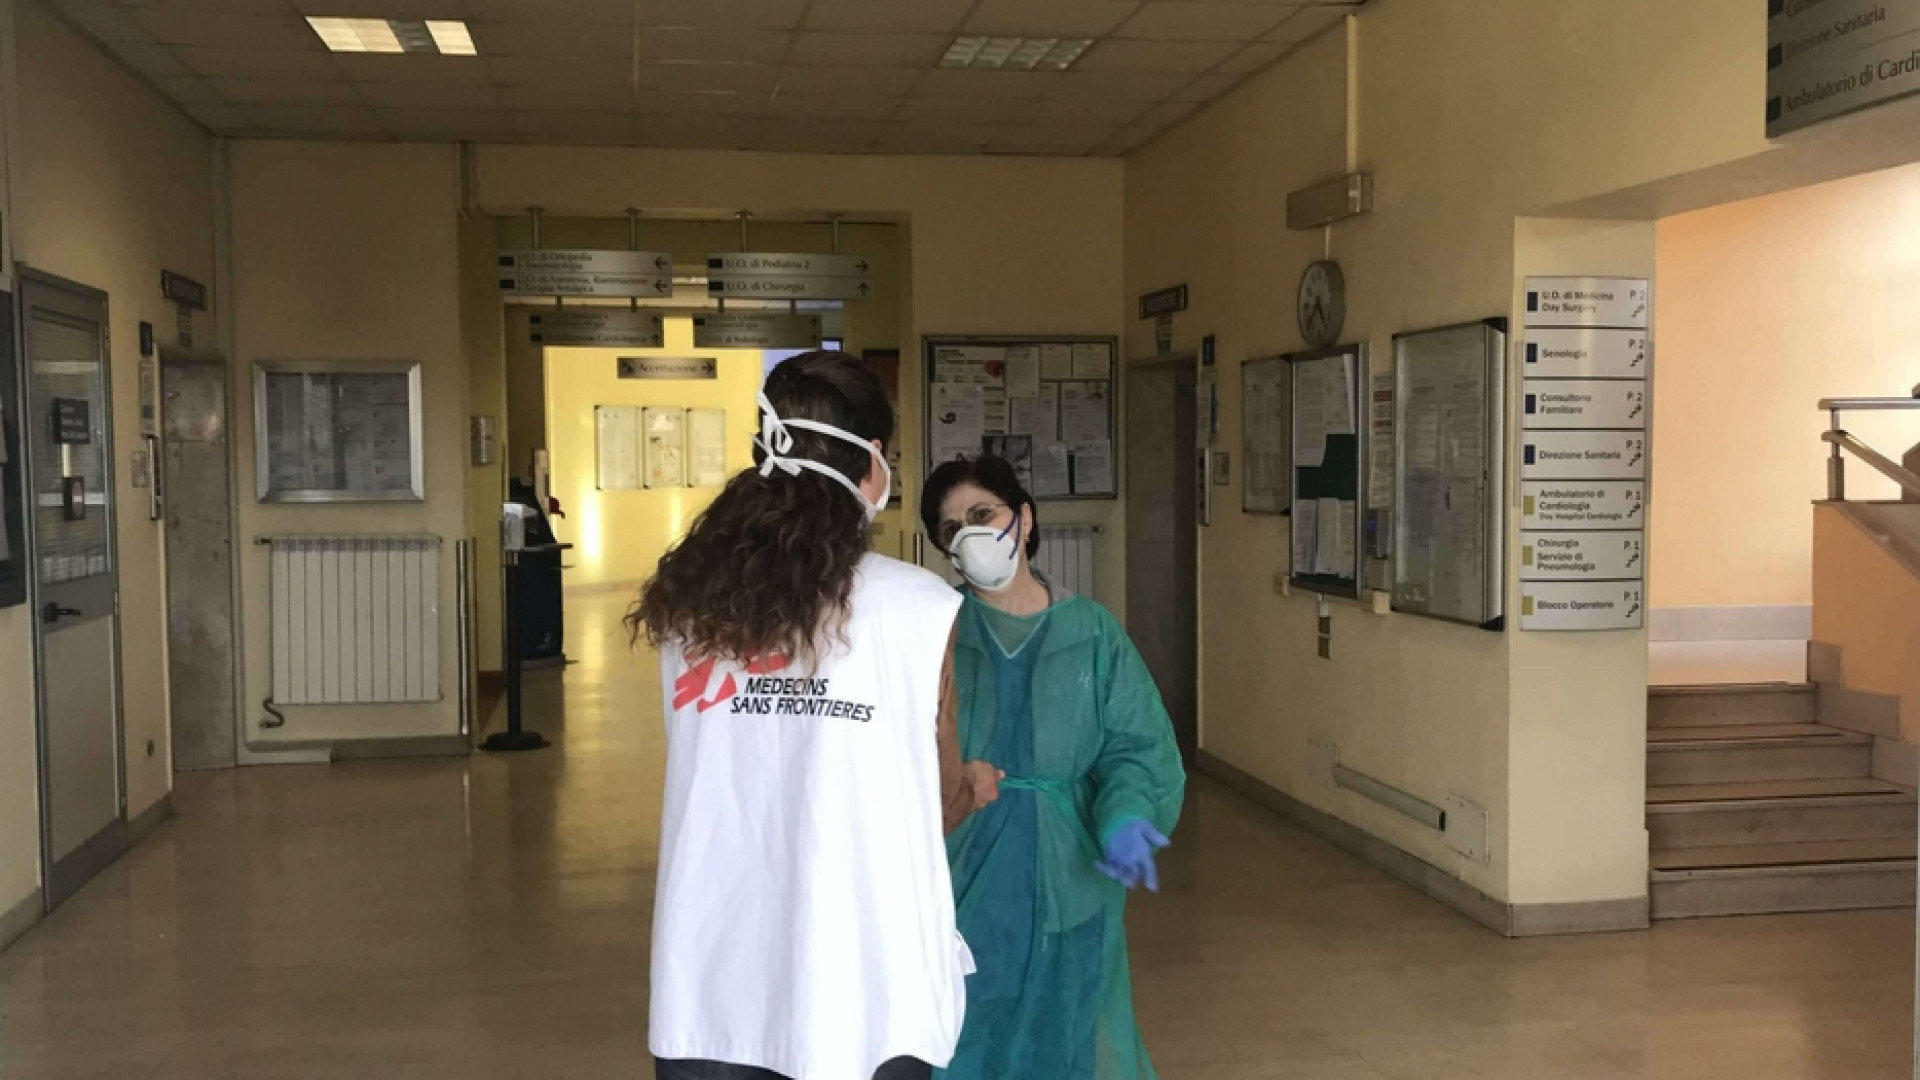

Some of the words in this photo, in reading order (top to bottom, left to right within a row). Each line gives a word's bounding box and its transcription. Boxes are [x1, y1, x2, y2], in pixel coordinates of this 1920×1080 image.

[1833, 6, 1885, 36] Sanitaria
[1786, 73, 1856, 112] Ambulatorio
[1860, 64, 1874, 86] di
[548, 252, 592, 263] Ortopedia
[725, 258, 747, 268] U.O.
[750, 258, 760, 268] di
[762, 258, 802, 269] Pediatria
[804, 259, 810, 269] 2
[726, 281, 748, 291] U.O.
[751, 281, 760, 291] di
[762, 281, 805, 293] Chirurgia
[1541, 290, 1561, 300] U.O.
[1563, 290, 1573, 300] di
[1541, 303, 1560, 313] Day
[1541, 347, 1587, 360] Senologia
[1540, 392, 1592, 403] Consultorio
[1626, 391, 1636, 402] P.
[1539, 404, 1584, 415] Familiare
[1625, 439, 1635, 450] P.
[1539, 450, 1582, 460] Direzione
[1584, 450, 1621, 460] Sanitaria
[1539, 489, 1596, 499] Ambulatorio
[1597, 489, 1605, 499] di
[1625, 490, 1634, 500] P.
[1539, 501, 1591, 512] Cardiologia
[1537, 539, 1579, 550] Chirurgia
[1623, 540, 1632, 550] P.
[1537, 552, 1574, 561] Servizio
[1574, 552, 1583, 561] di
[1537, 562, 1596, 573] Pneumologia
[1623, 591, 1632, 602] P.
[1537, 600, 1569, 610] Blocco
[1570, 600, 1615, 611] Operatorio
[743, 677, 829, 697] MEDECINS
[730, 696, 773, 715] SANS
[774, 697, 875, 723] FRONTIERES
